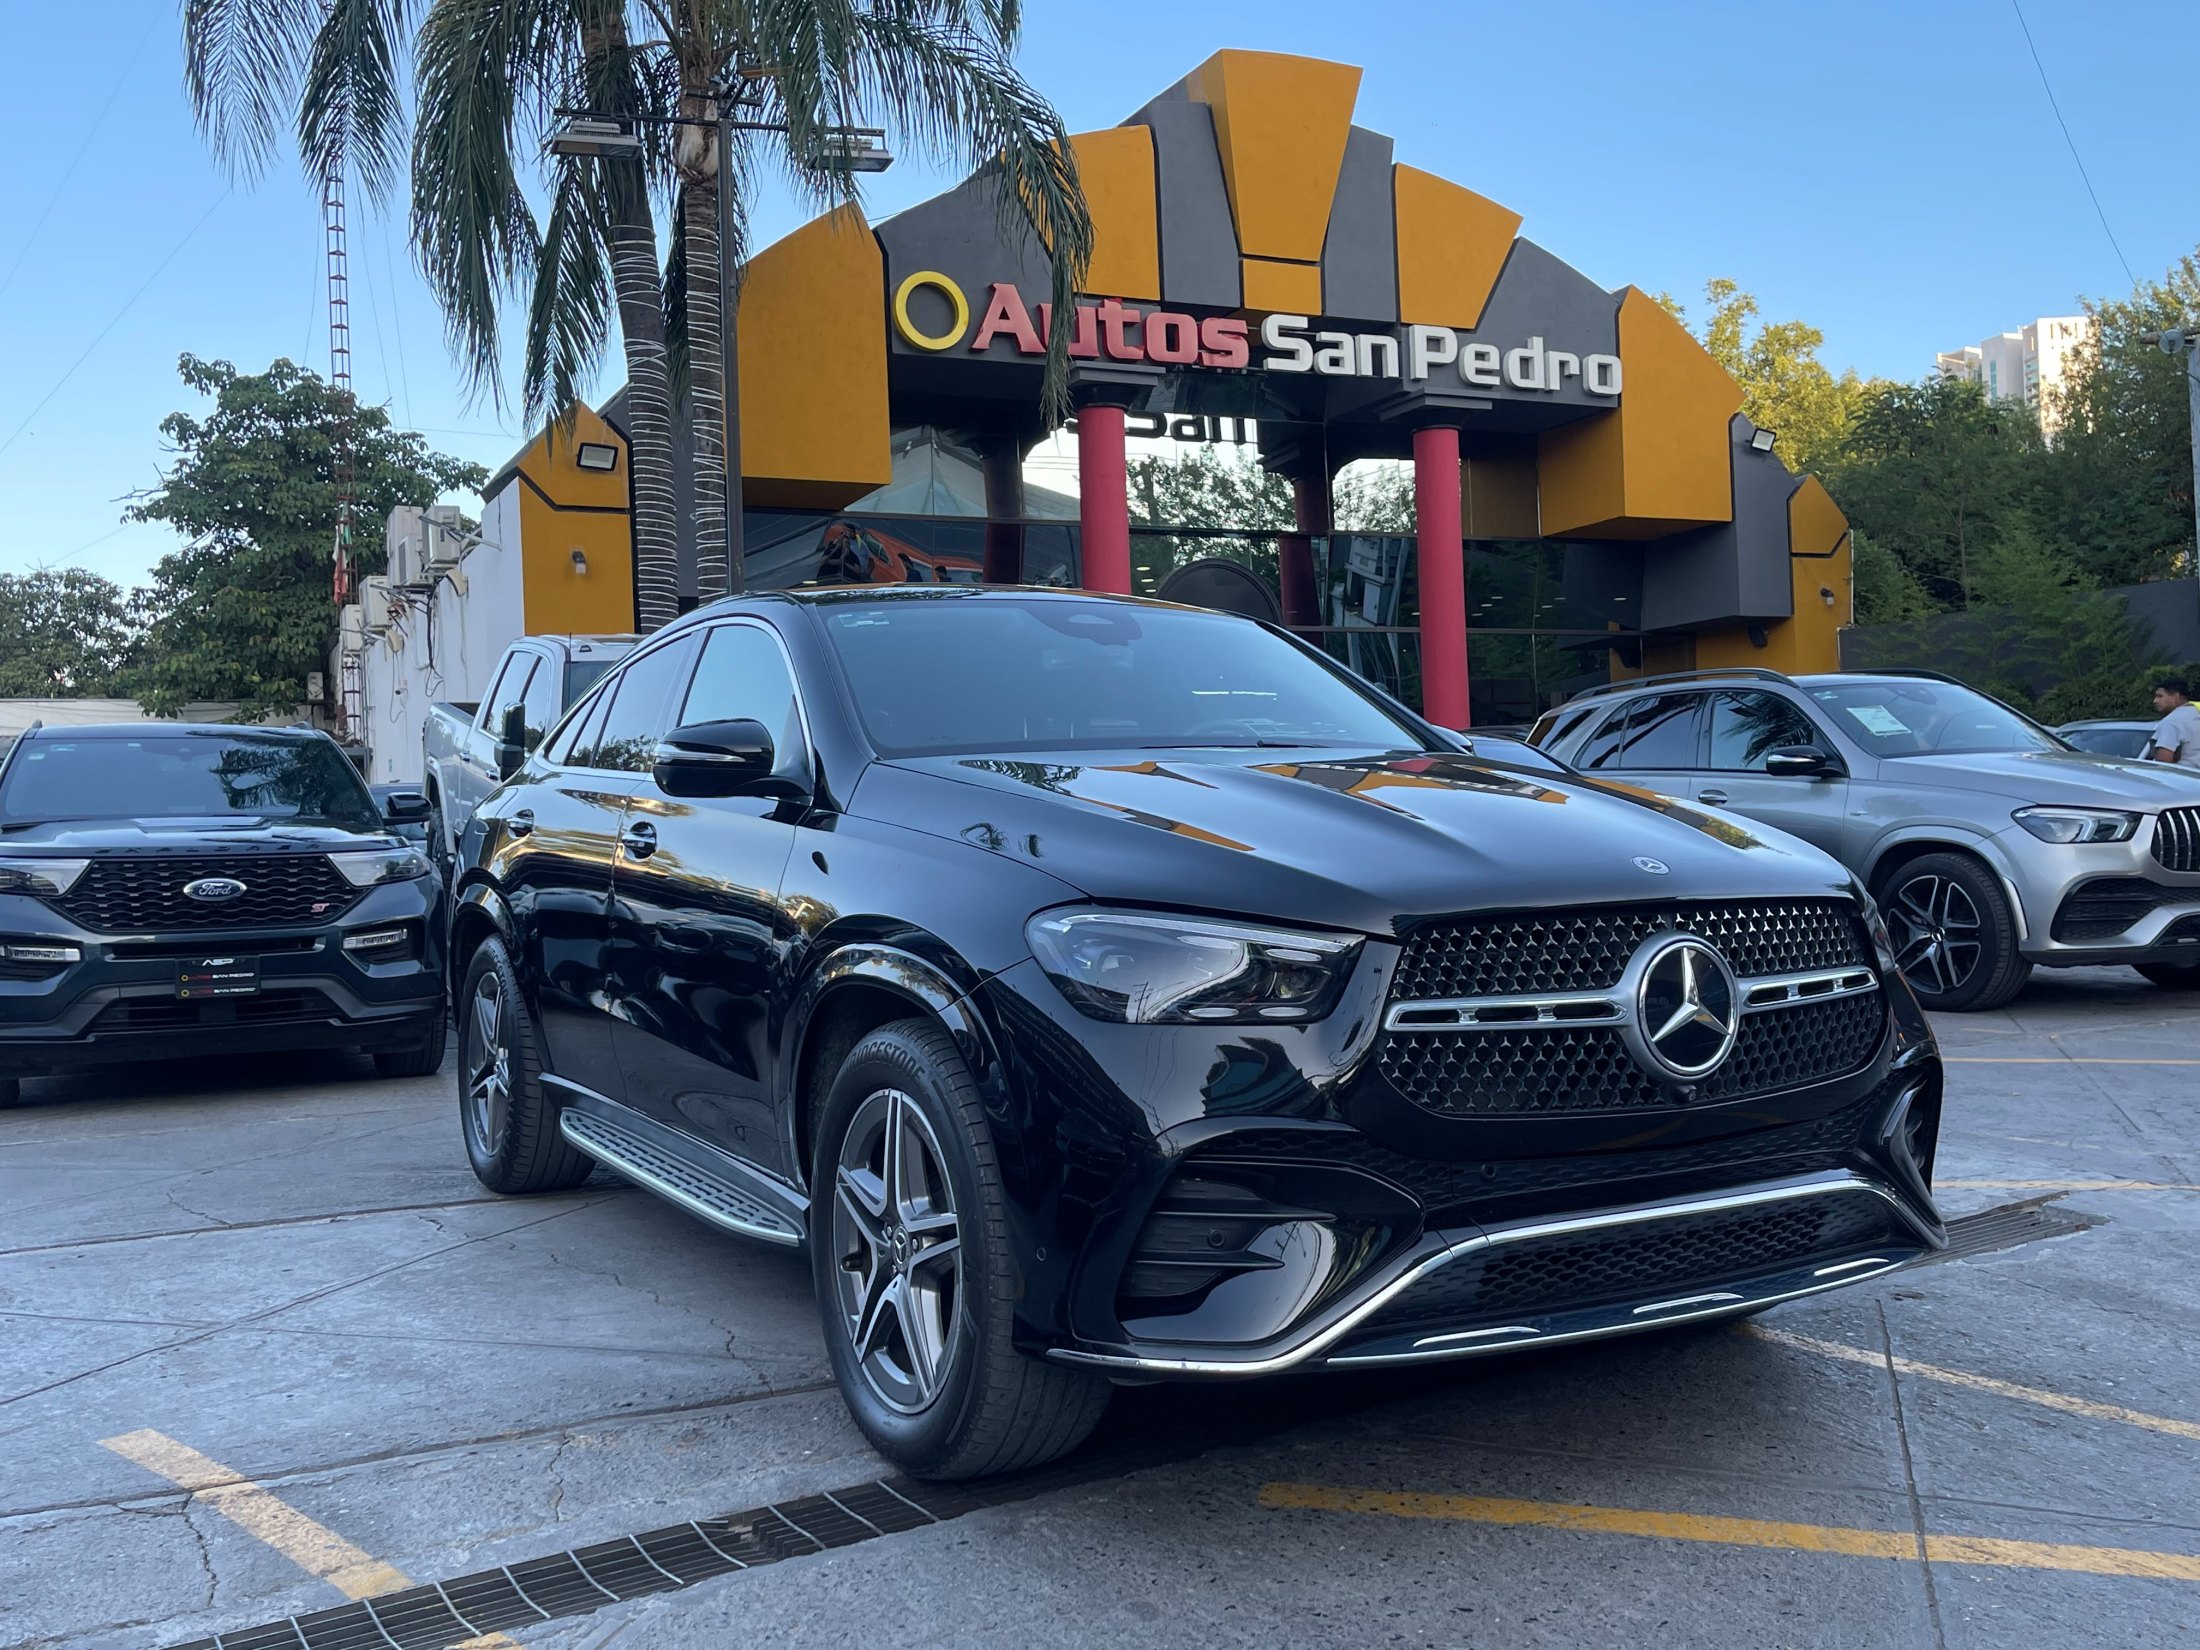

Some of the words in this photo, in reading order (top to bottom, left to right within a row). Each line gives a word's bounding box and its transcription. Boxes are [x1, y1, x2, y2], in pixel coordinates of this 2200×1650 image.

[971, 281, 1250, 369] Autos
[1260, 313, 1400, 379] San
[1409, 324, 1623, 396] Pedro
[199, 882, 232, 896] Ford
[311, 902, 330, 913] ST
